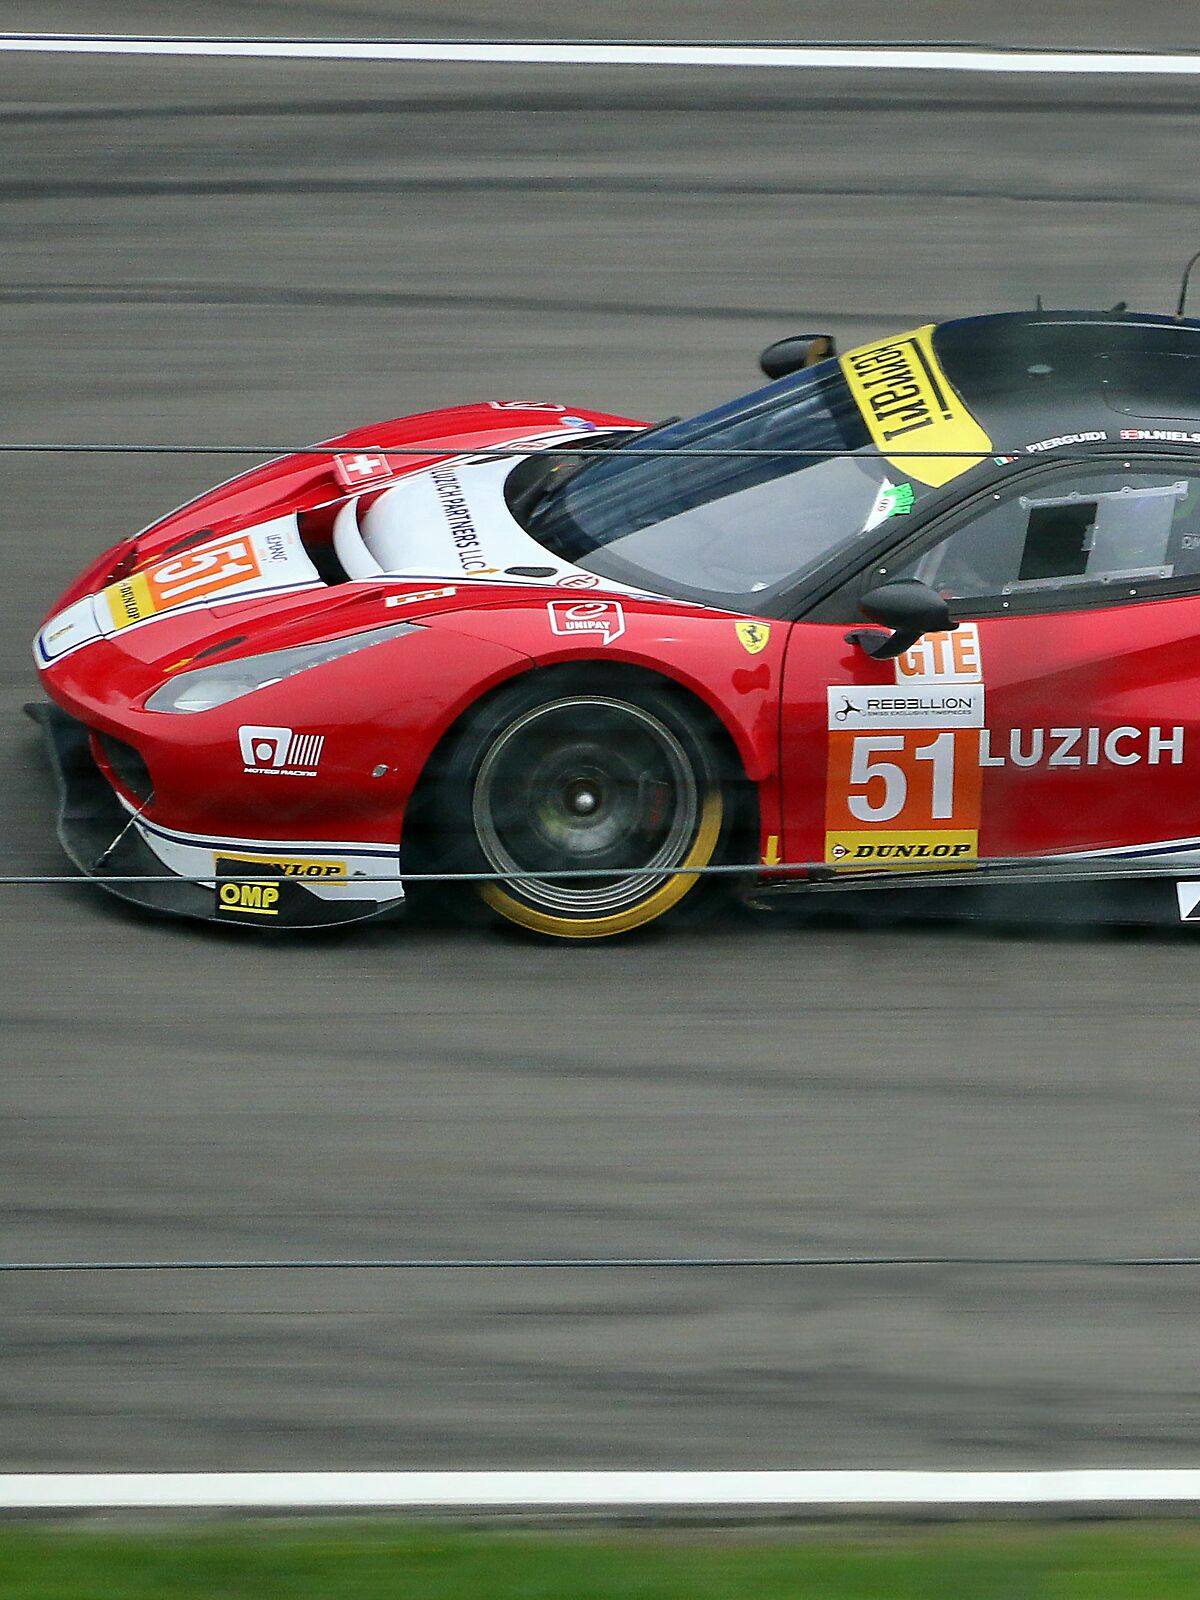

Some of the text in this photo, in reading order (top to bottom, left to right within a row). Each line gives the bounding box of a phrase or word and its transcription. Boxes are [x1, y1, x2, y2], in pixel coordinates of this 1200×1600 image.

[1025, 431, 1107, 453] PIERGUIDI
[440, 498, 480, 548] PARTNERS
[152, 542, 254, 601] 51
[458, 549, 487, 570] LLC
[119, 584, 141, 620] DUNLOP
[565, 621, 611, 631] UNIPAY
[898, 631, 978, 677] GTE
[867, 698, 972, 709] REBELLION
[978, 726, 1185, 767] LUZICH
[280, 769, 318, 777] RACING
[847, 732, 956, 823] 51
[853, 844, 972, 859] DUNLOP
[269, 863, 342, 877] NLOP
[219, 882, 280, 909] OMP
